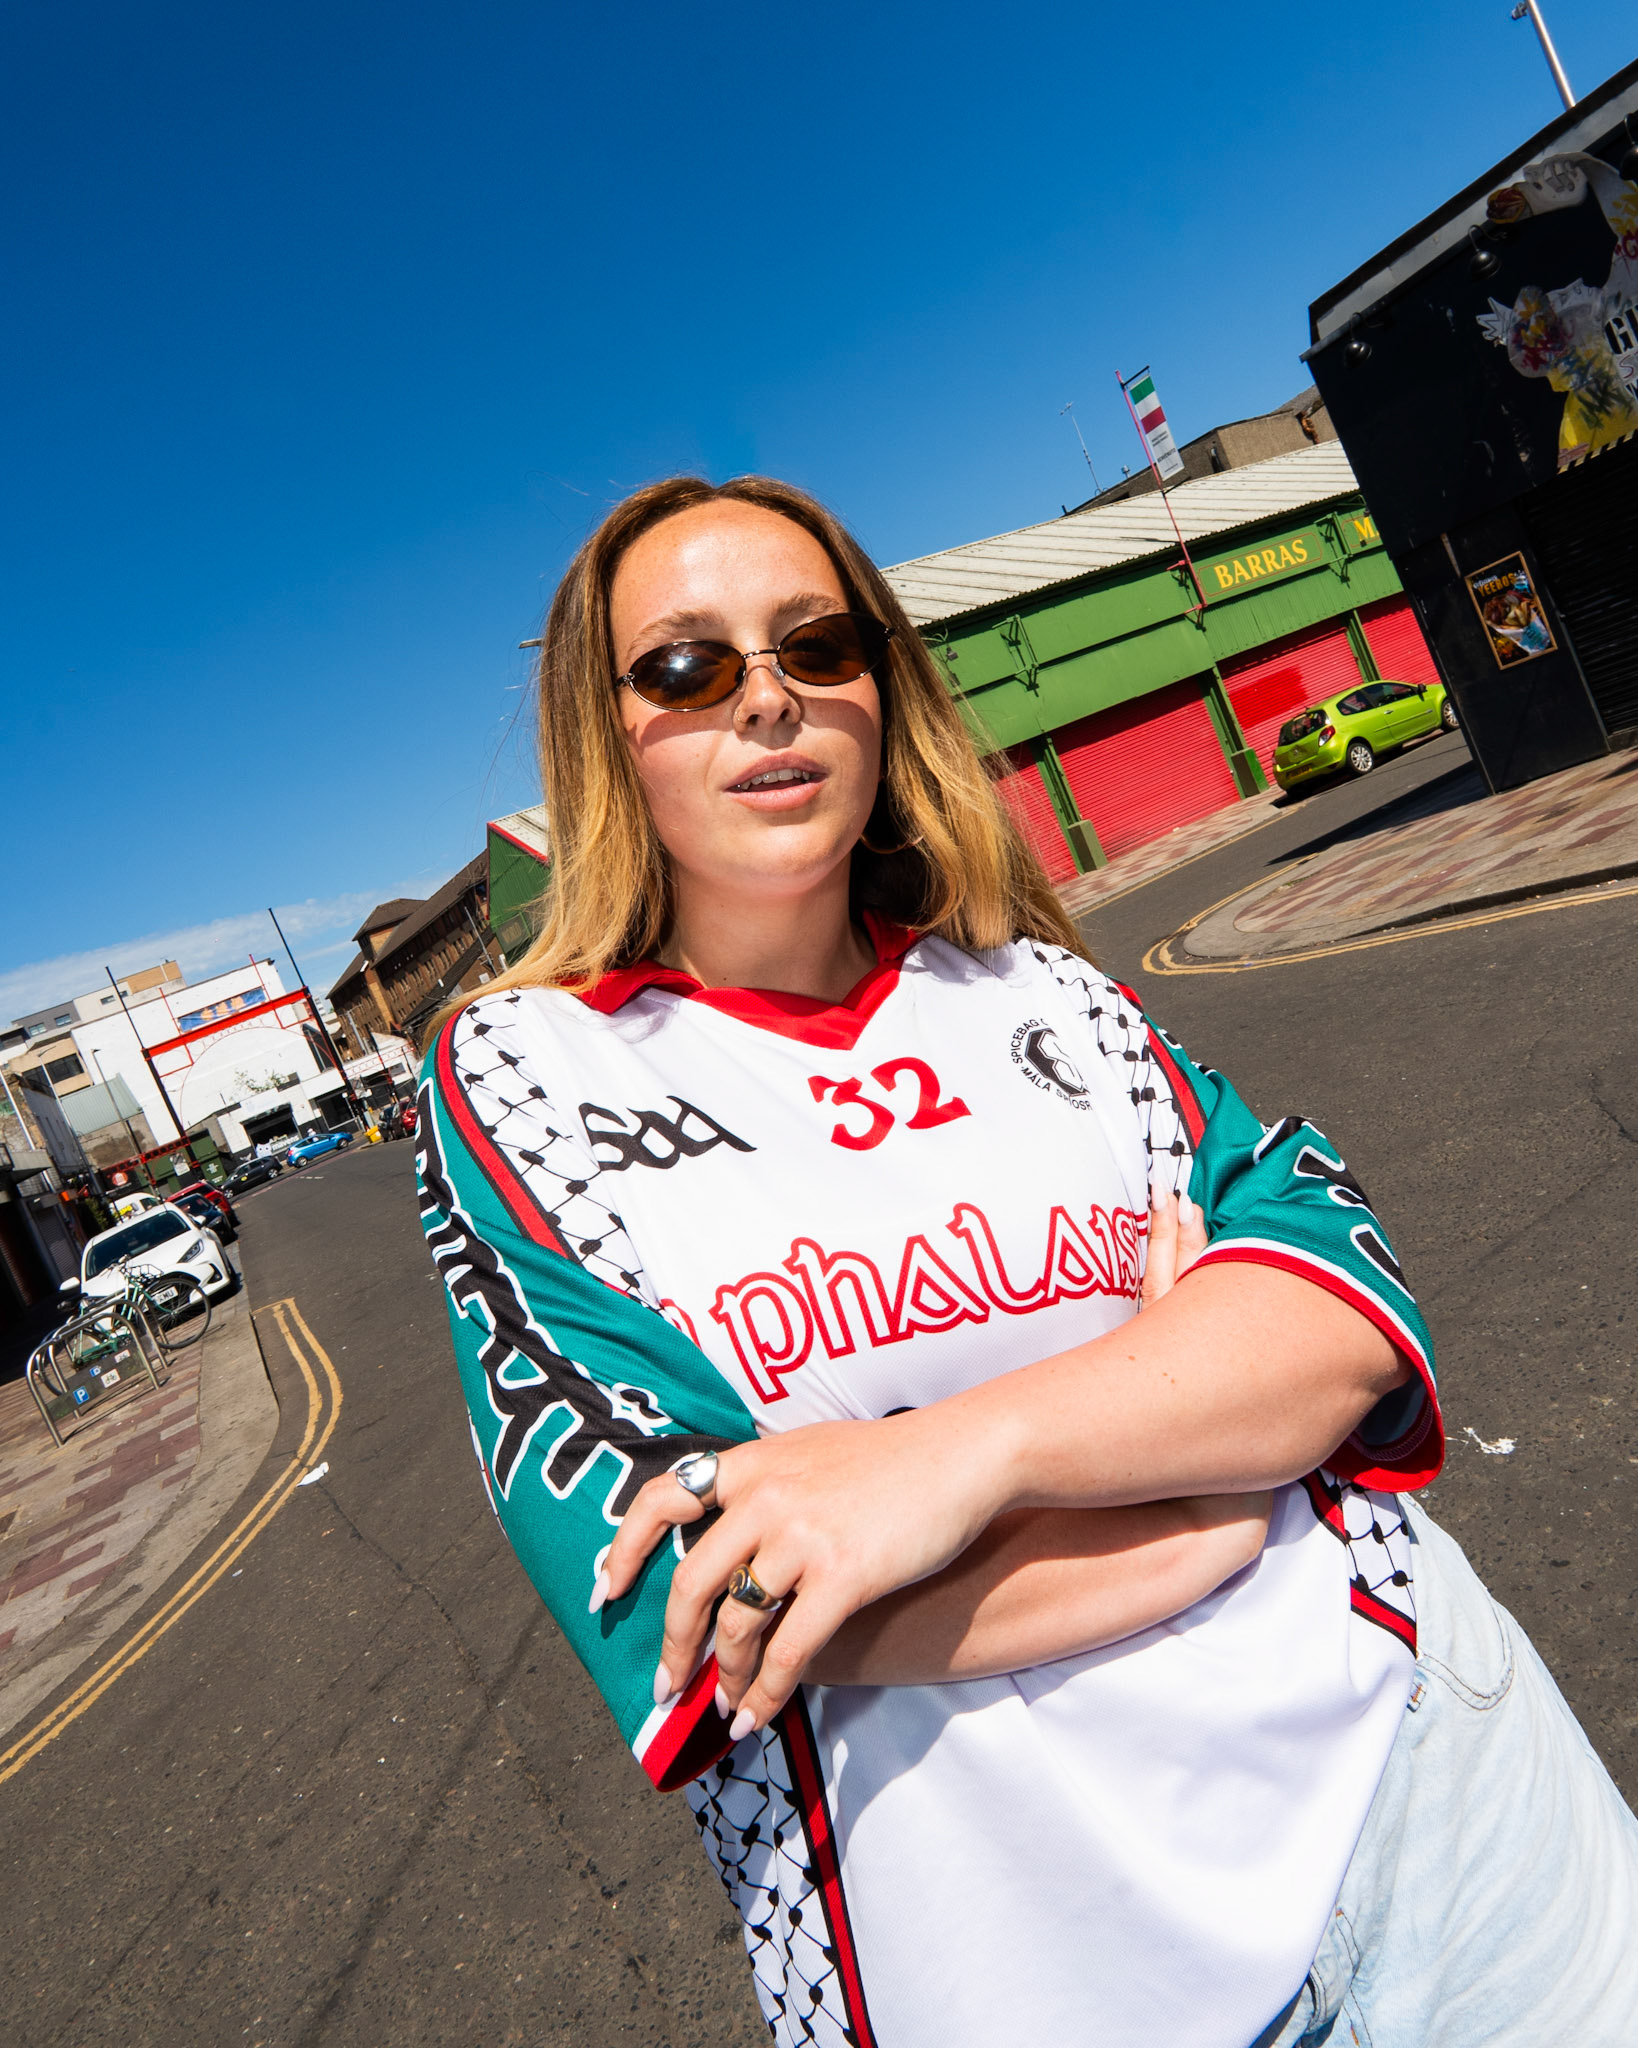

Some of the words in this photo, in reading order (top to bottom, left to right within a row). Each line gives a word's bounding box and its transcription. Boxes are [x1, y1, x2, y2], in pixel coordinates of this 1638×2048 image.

[1214, 539, 1307, 588] BARRAS
[1353, 516, 1379, 542] M
[1477, 572, 1516, 597] YEEROS
[1010, 1019, 1040, 1064] SPICEBAG
[807, 1056, 972, 1151] 32
[76, 1388, 86, 1403] P
